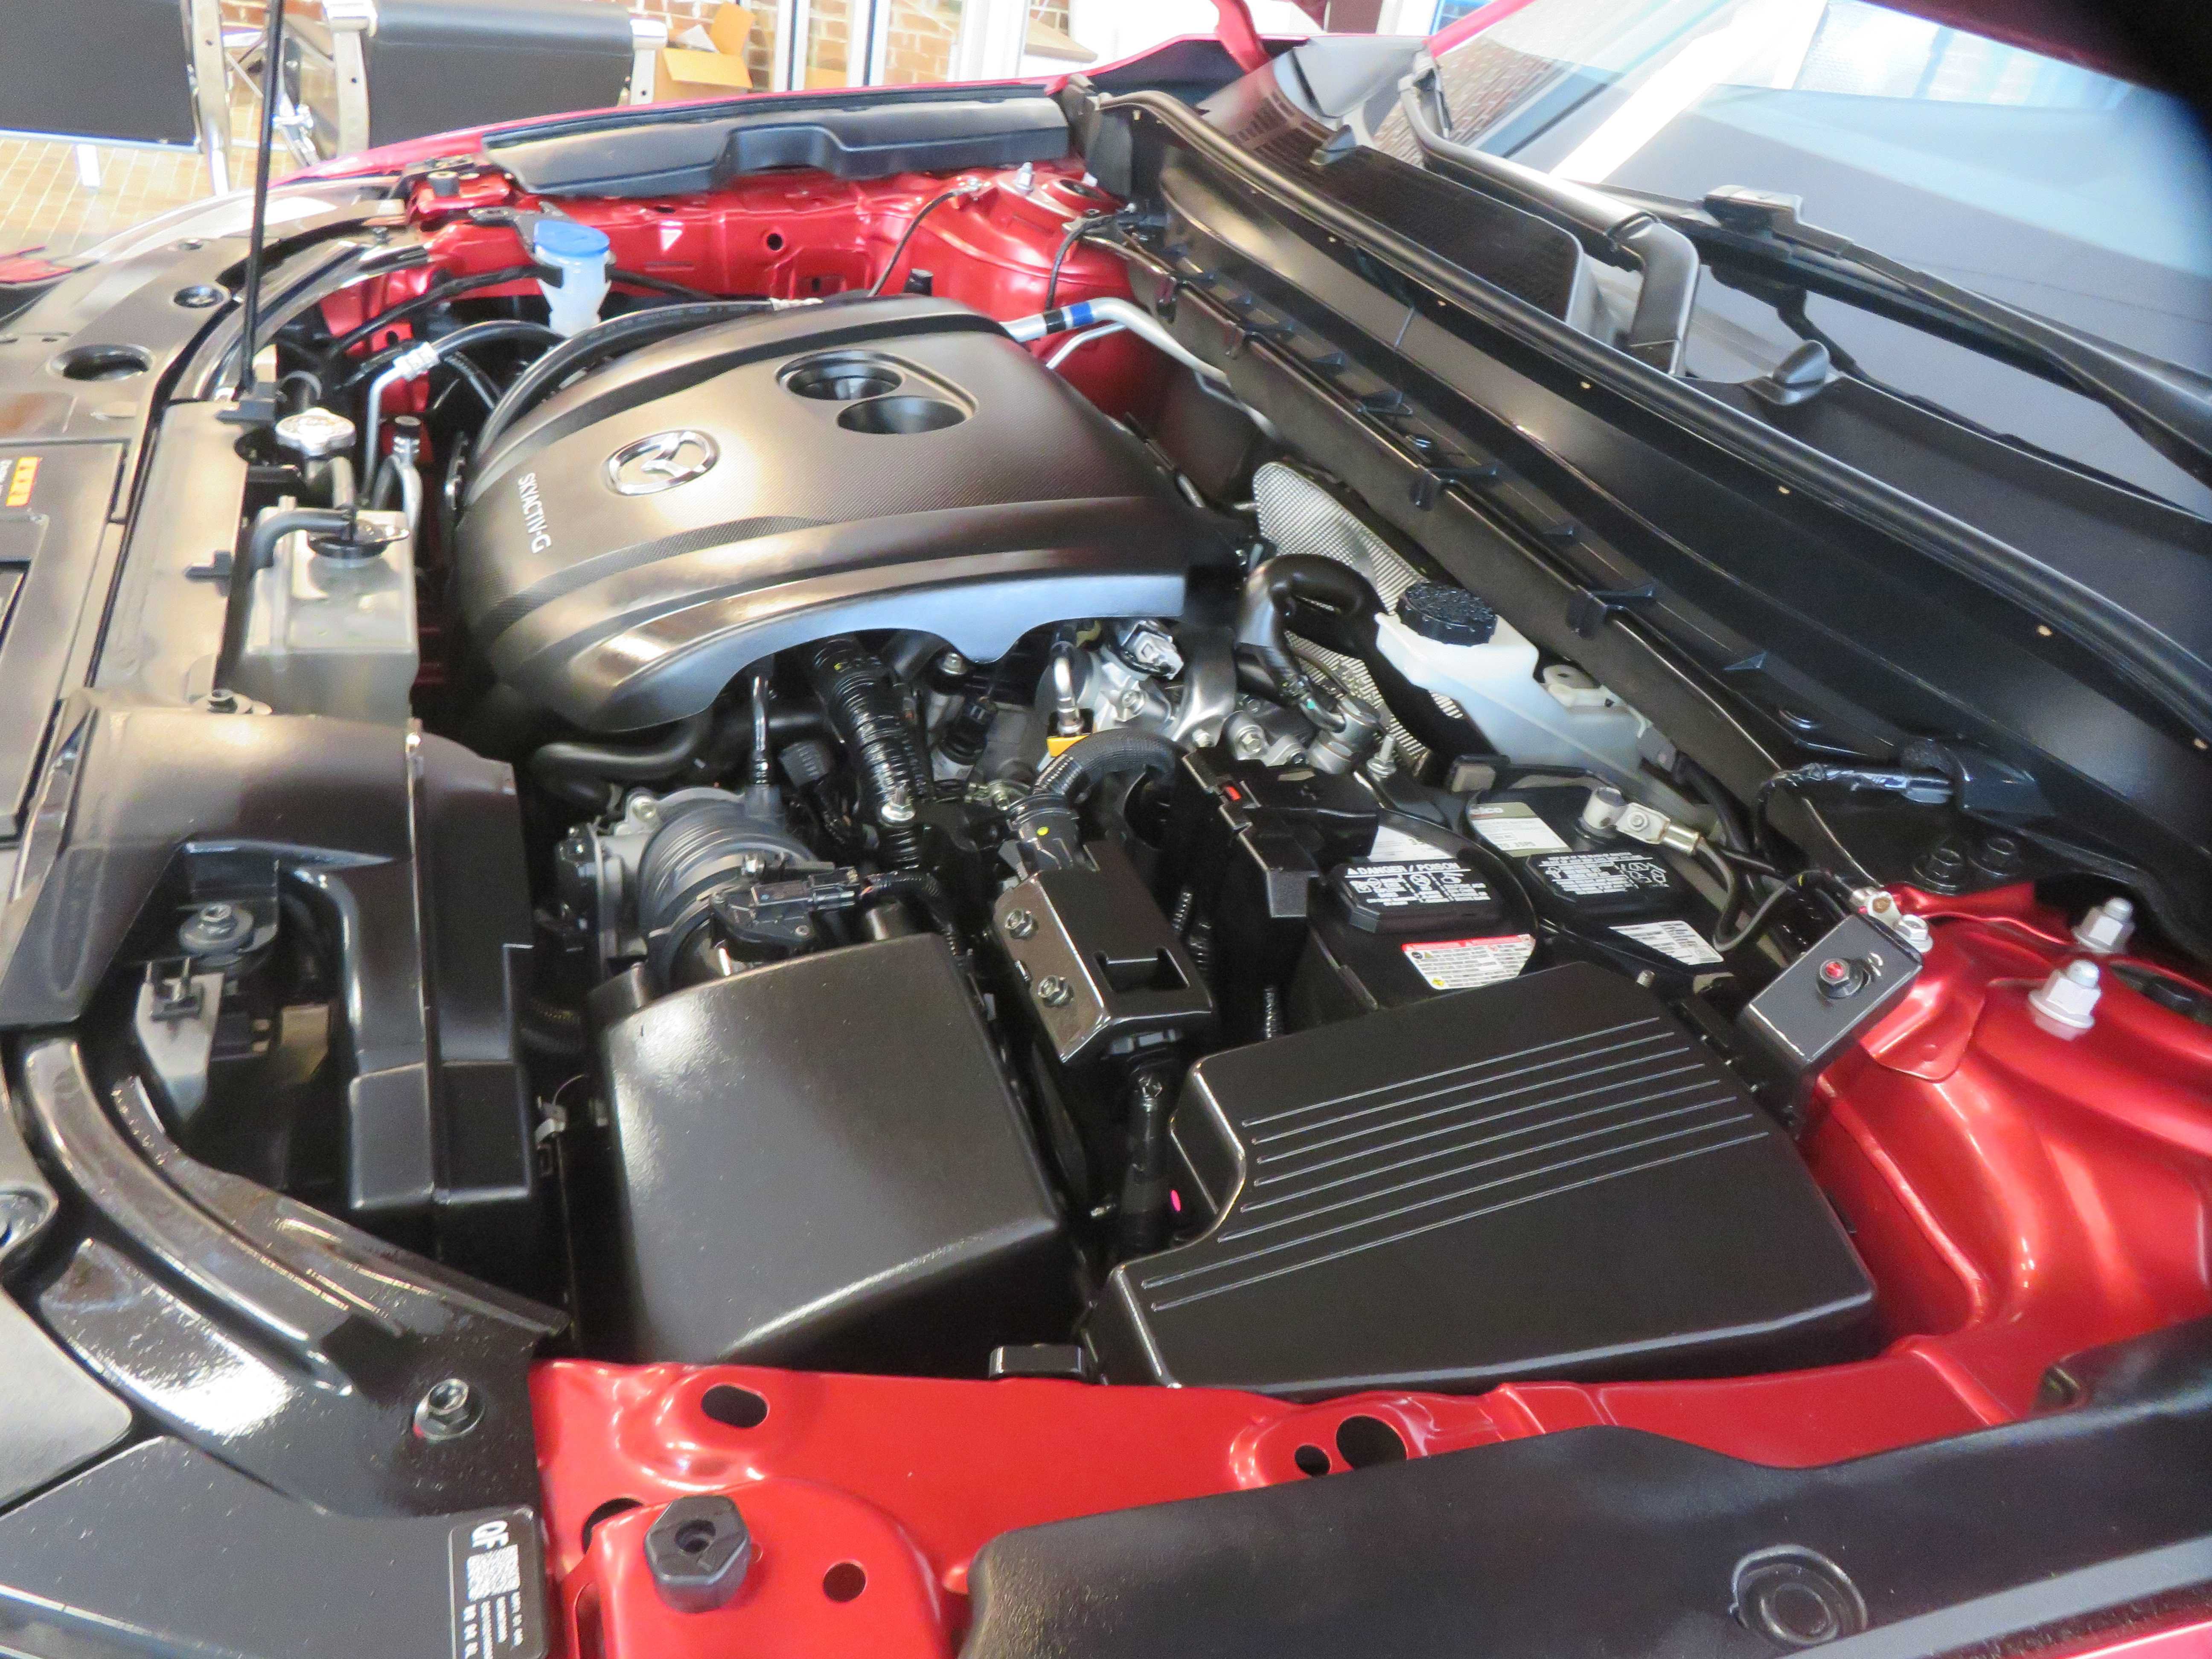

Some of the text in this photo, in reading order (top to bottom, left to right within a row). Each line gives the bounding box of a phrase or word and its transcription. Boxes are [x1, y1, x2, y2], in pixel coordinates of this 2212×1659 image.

[518, 472, 552, 554] SKYACTIV-G
[1356, 865, 1408, 875] DANGER
[1415, 862, 1461, 871] POISON
